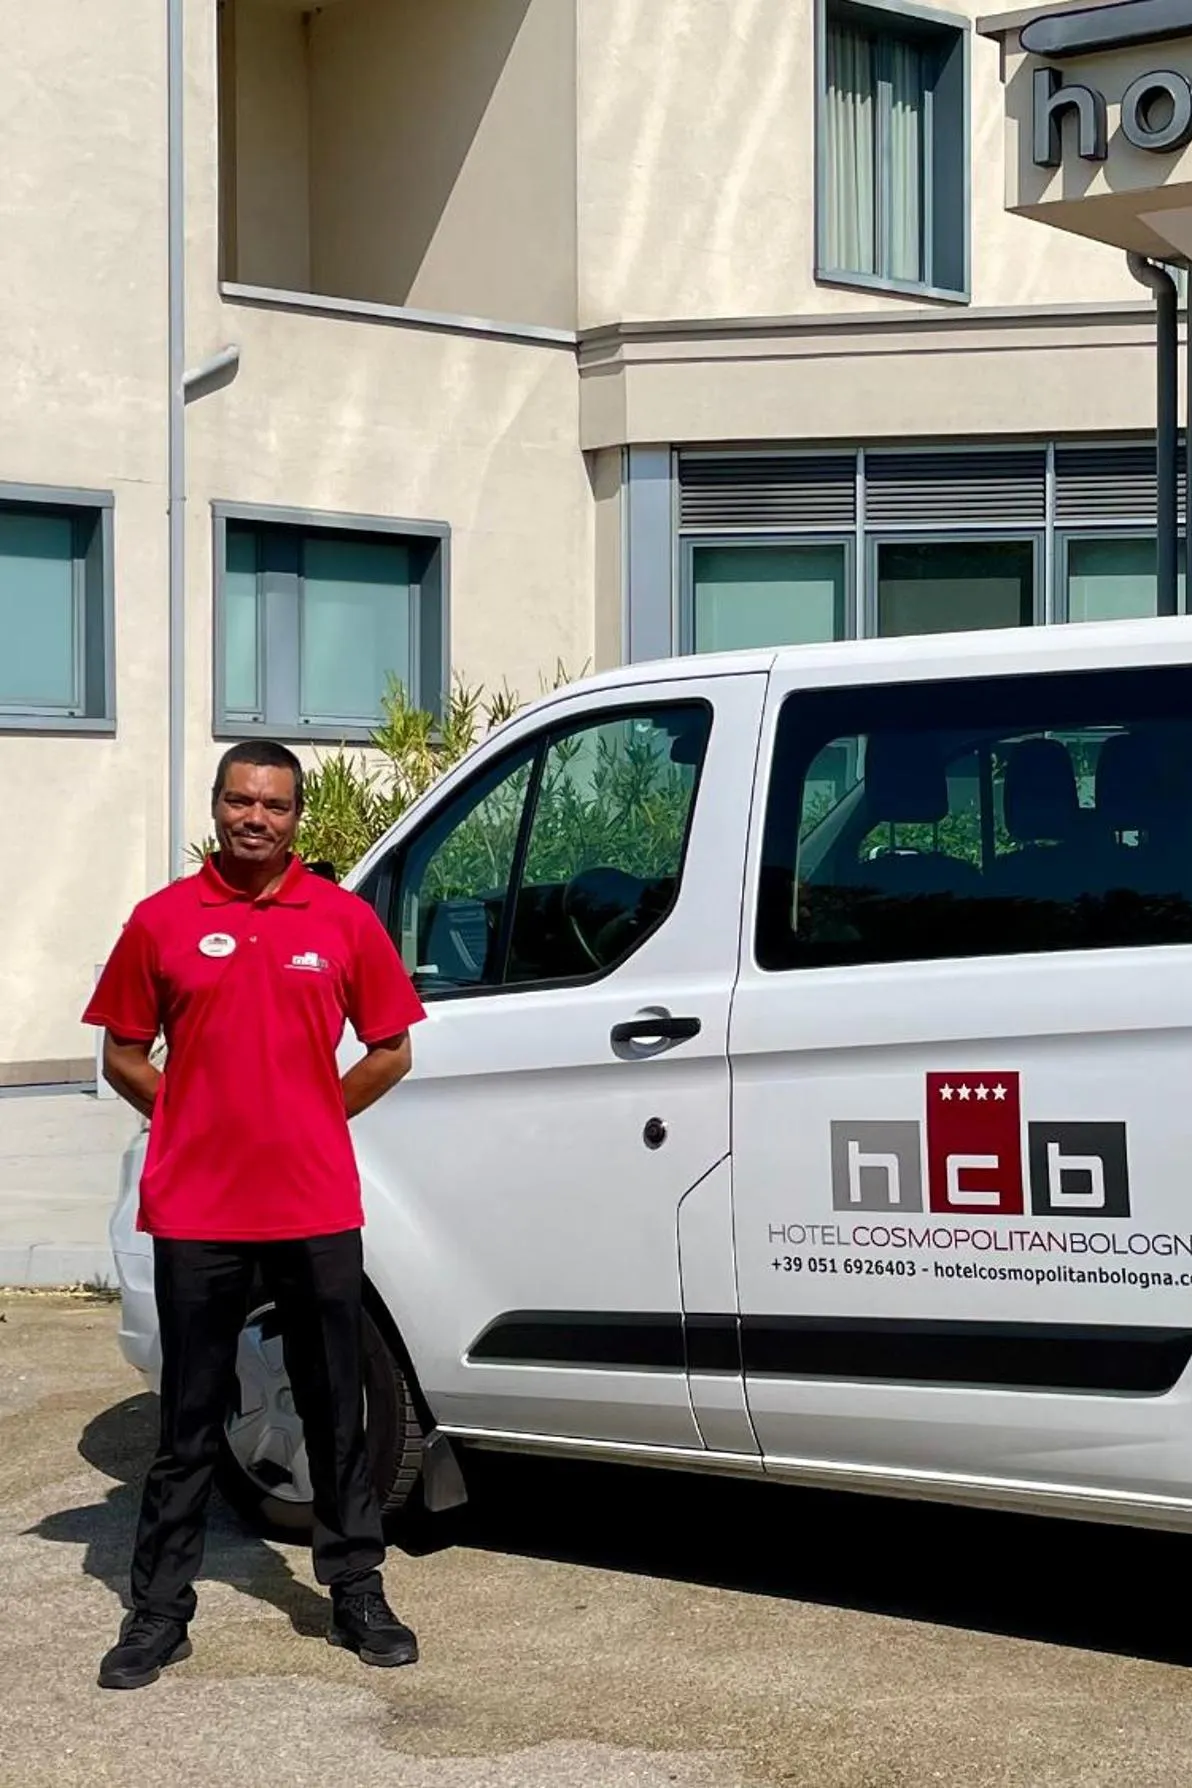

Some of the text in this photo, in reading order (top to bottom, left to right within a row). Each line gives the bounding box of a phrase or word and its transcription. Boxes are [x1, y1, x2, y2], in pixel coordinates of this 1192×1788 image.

[848, 1140, 1106, 1209] hcb
[771, 1256, 801, 1272] +39
[808, 1257, 837, 1273] 051
[843, 1259, 916, 1276] 6926403
